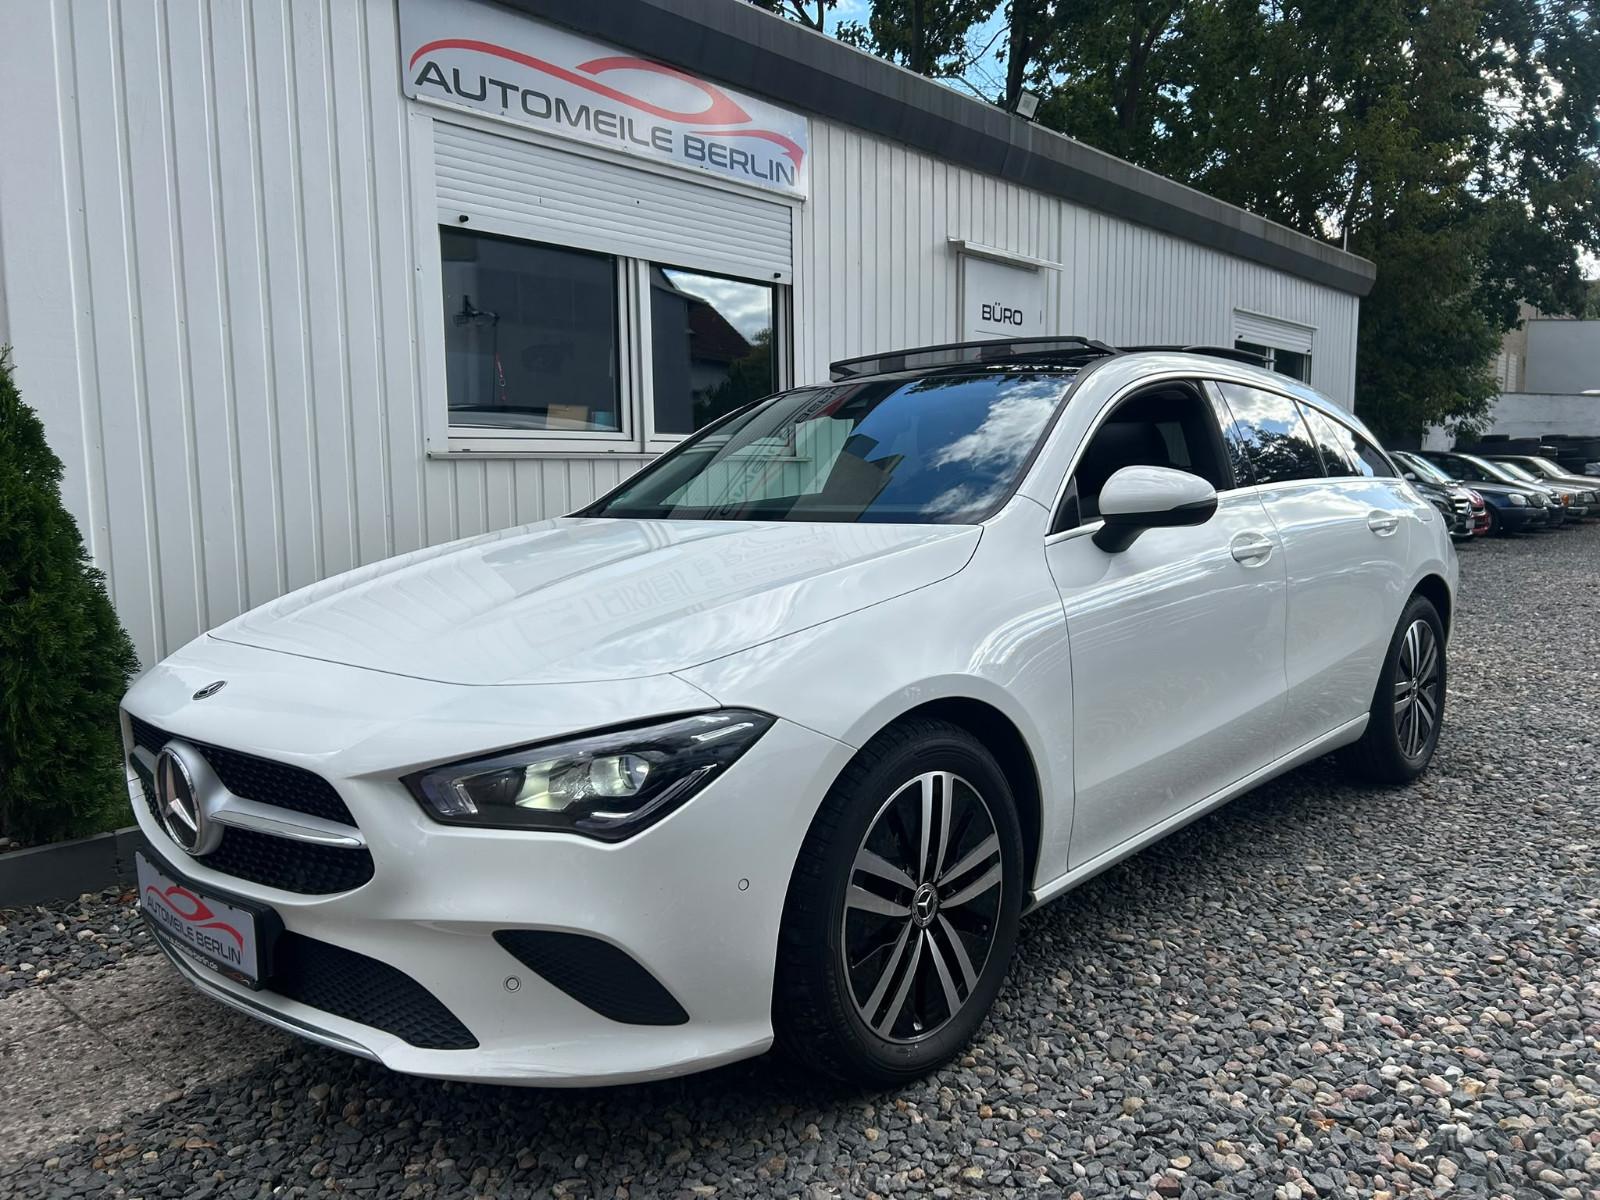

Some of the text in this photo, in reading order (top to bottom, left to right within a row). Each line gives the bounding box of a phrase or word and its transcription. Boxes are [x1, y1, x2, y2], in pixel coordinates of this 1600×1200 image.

[414, 61, 795, 187] AUTOMEILE BERLIN
[981, 302, 1023, 326] BÜRO
[147, 897, 195, 942] AUTOMEILE
[196, 931, 241, 965] BERLIN
